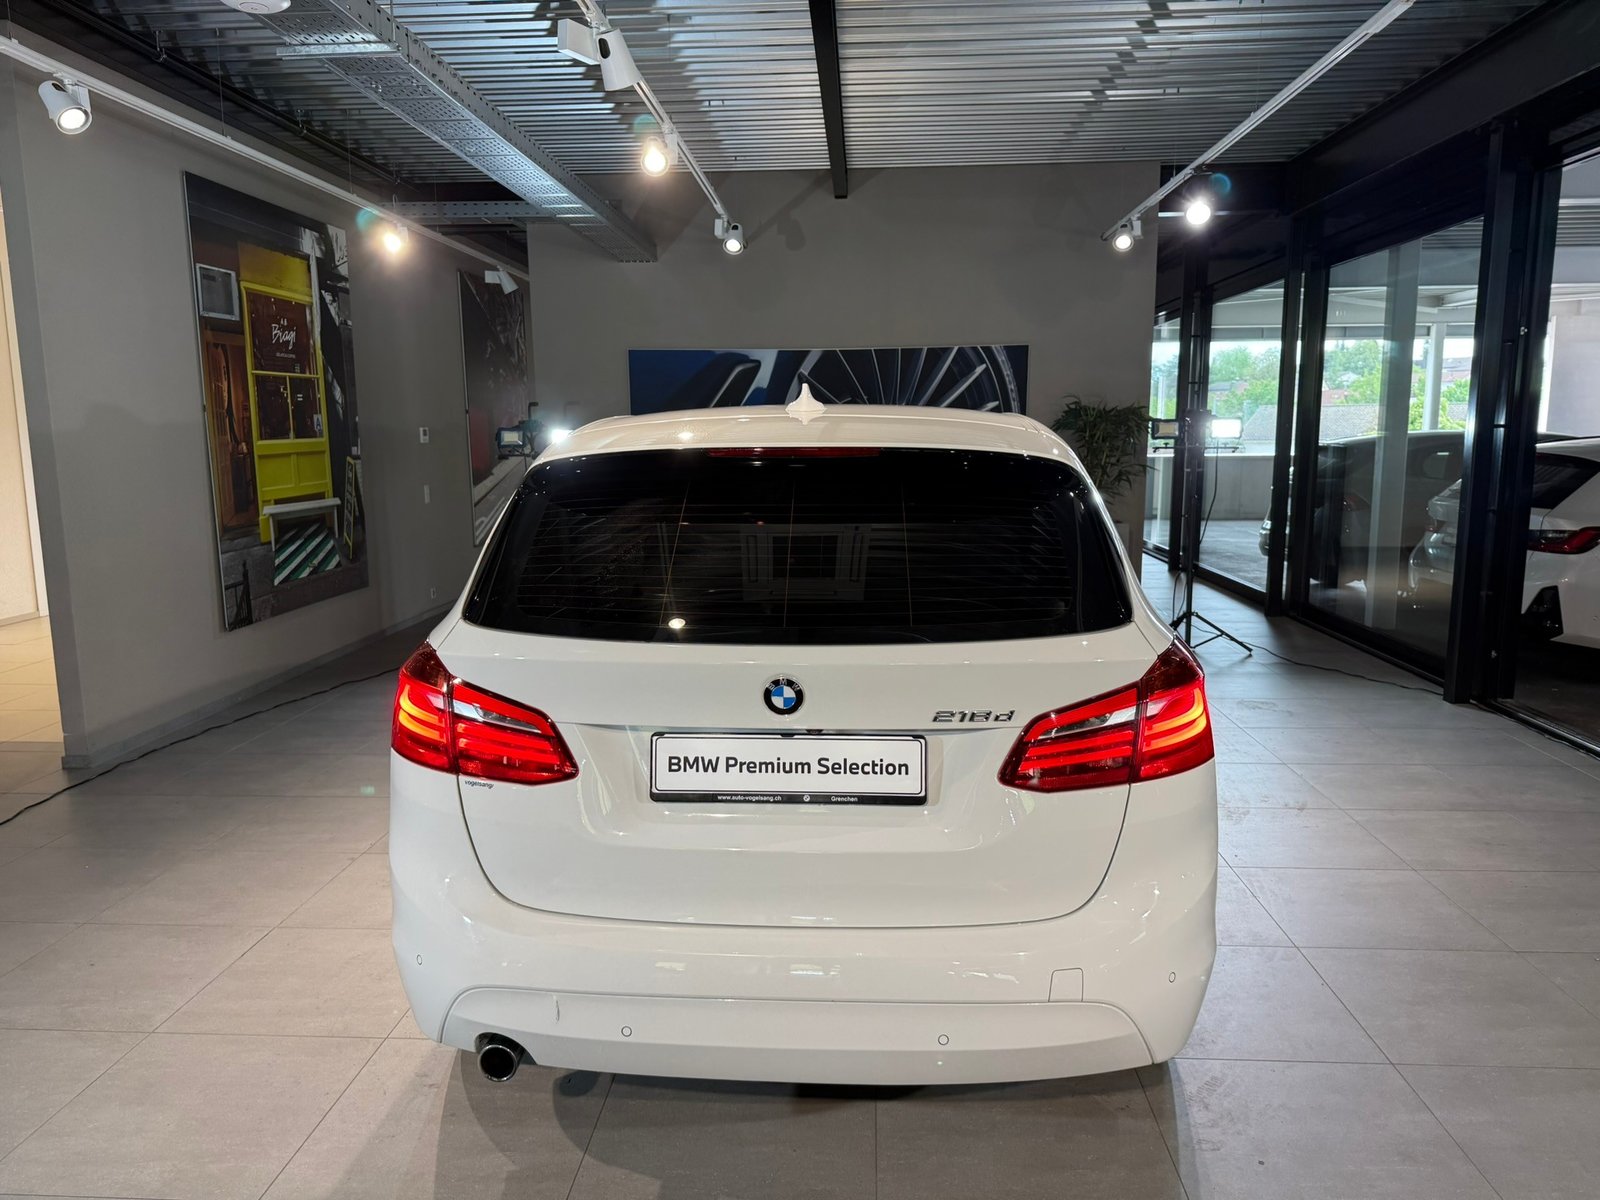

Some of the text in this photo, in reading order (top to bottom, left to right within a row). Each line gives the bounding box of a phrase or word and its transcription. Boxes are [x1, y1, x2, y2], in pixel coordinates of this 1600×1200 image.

[271, 324, 297, 350] Biagi
[932, 710, 1015, 722] 218d
[668, 756, 909, 775] BMW Premium Selection
[717, 794, 782, 802] www.auto-vogelsang.ch
